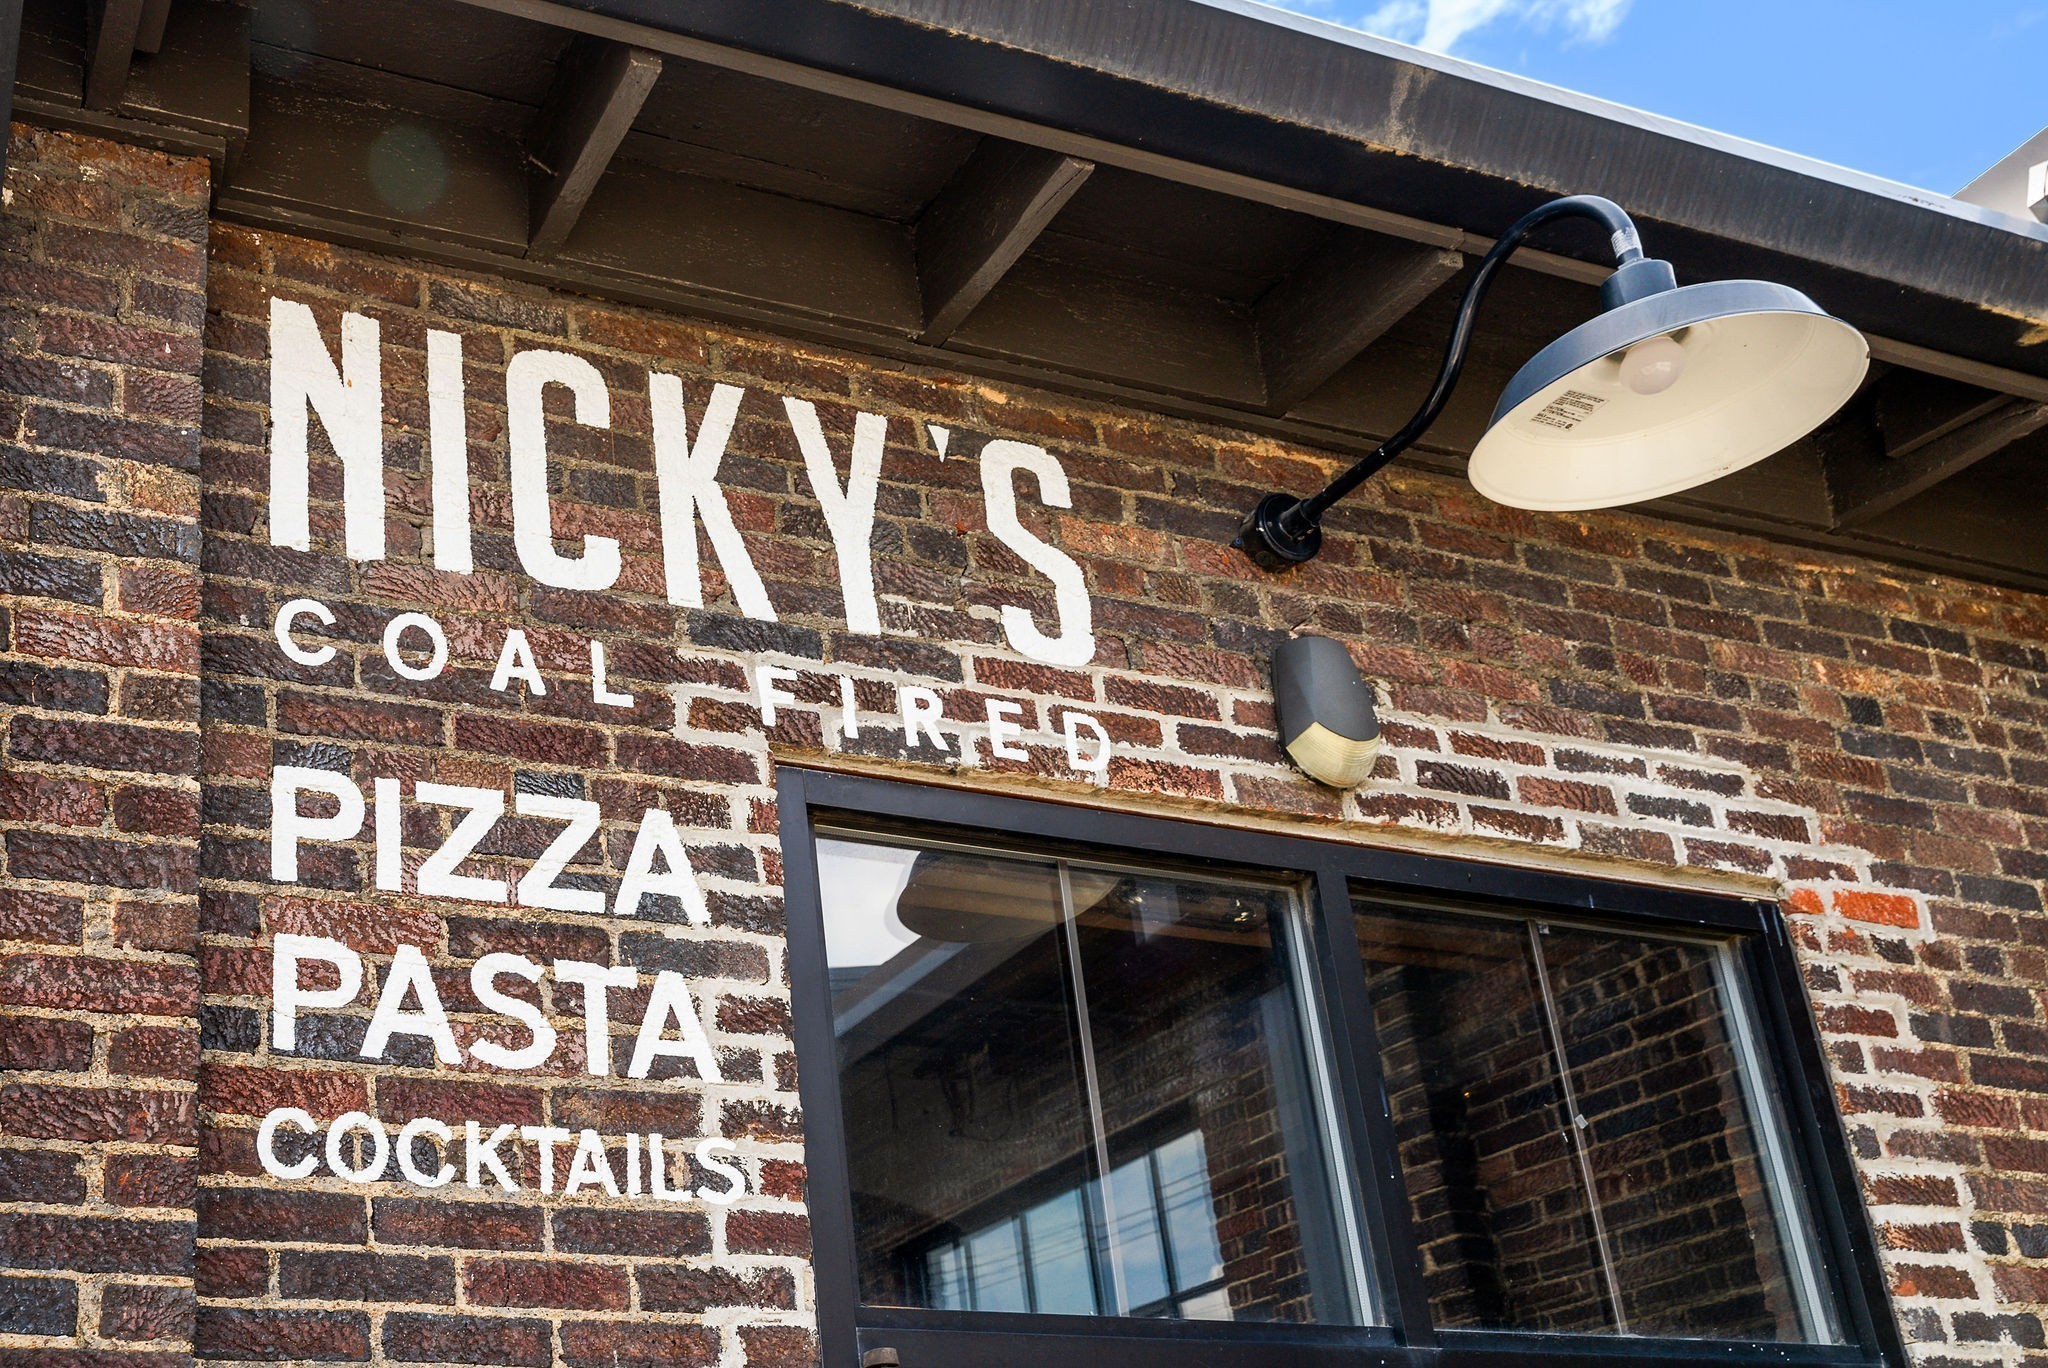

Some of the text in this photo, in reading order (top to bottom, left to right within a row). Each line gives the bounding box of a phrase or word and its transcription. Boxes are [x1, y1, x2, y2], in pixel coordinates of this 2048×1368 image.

[269, 296, 1096, 668] NICKY'S
[276, 599, 1111, 773] COAL FIRED
[271, 765, 712, 925] PIZZA
[273, 932, 723, 1083] PASTA
[256, 1107, 747, 1204] COCKTAILS
